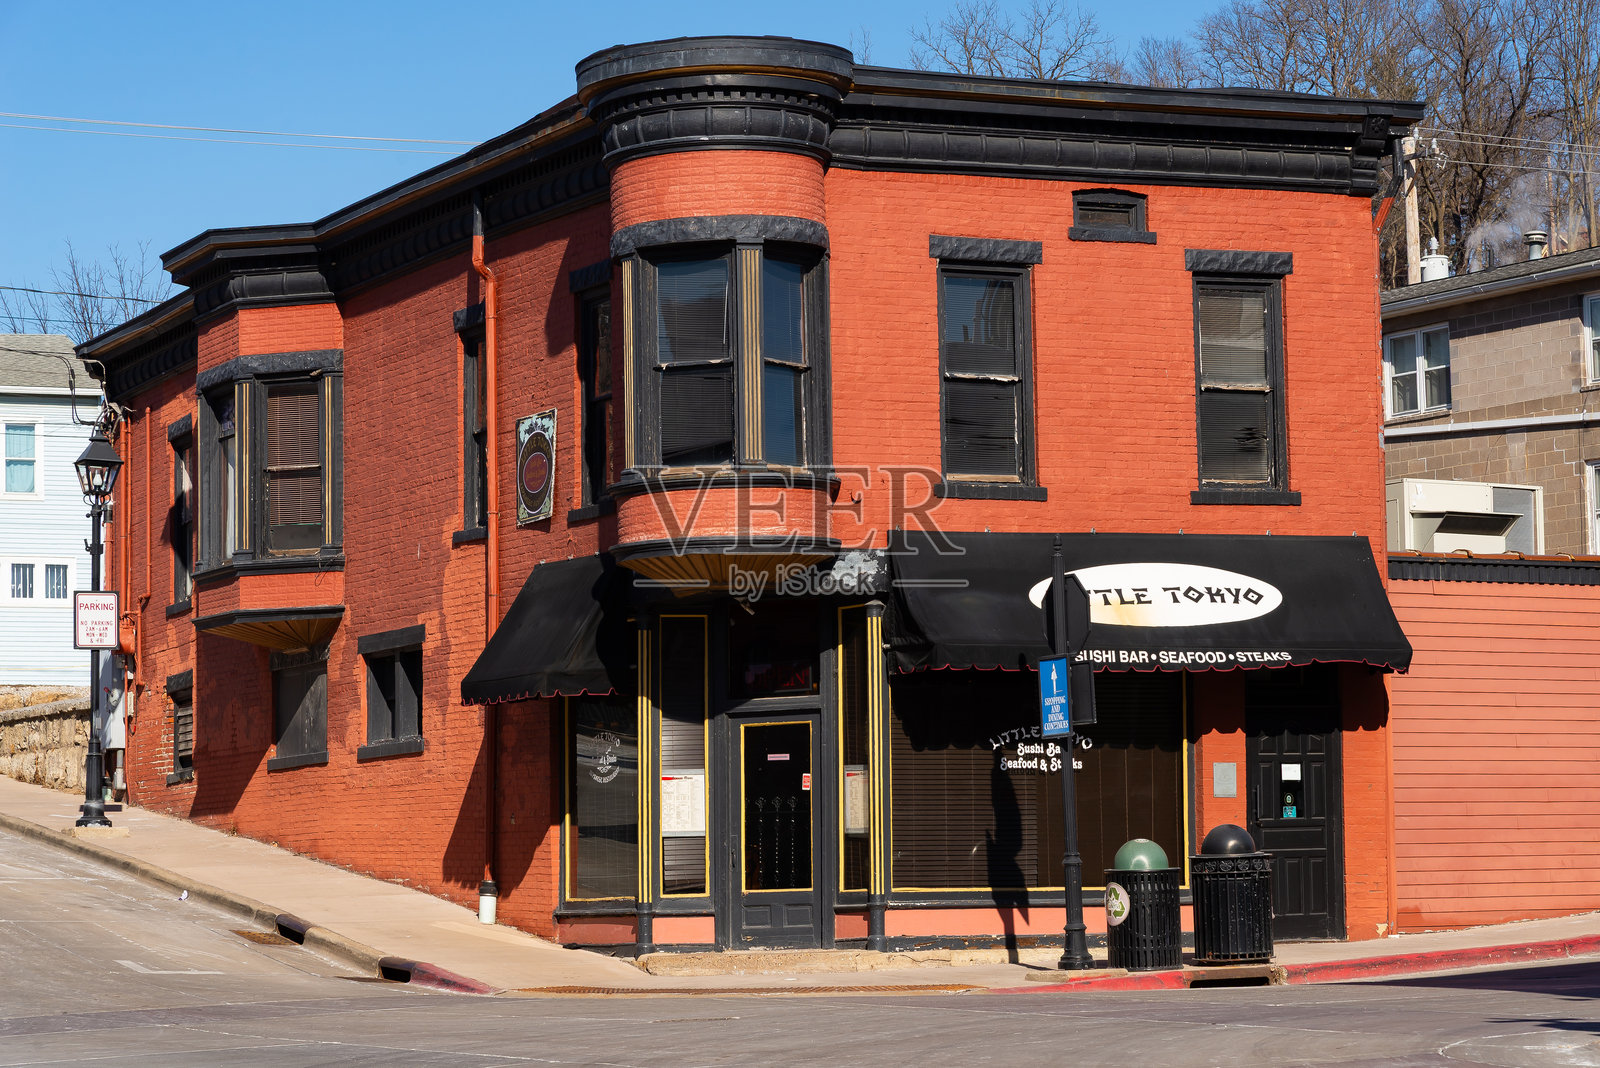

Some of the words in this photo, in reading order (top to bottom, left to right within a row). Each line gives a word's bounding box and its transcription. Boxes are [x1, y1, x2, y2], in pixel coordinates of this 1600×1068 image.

[1087, 587, 1153, 606] TLE
[1161, 585, 1264, 606] TOKYO
[1119, 651, 1150, 663] BAR
[1159, 651, 1227, 664] SEAFOOD
[1236, 650, 1293, 663] STEAKS
[1051, 704, 1060, 713] AND
[989, 726, 1041, 751] LITTLE
[1017, 742, 1044, 756] Sushi
[1046, 742, 1062, 757] Ba
[1000, 756, 1038, 771] Seafood
[1040, 759, 1048, 773] &
[1050, 757, 1083, 772] Stks
